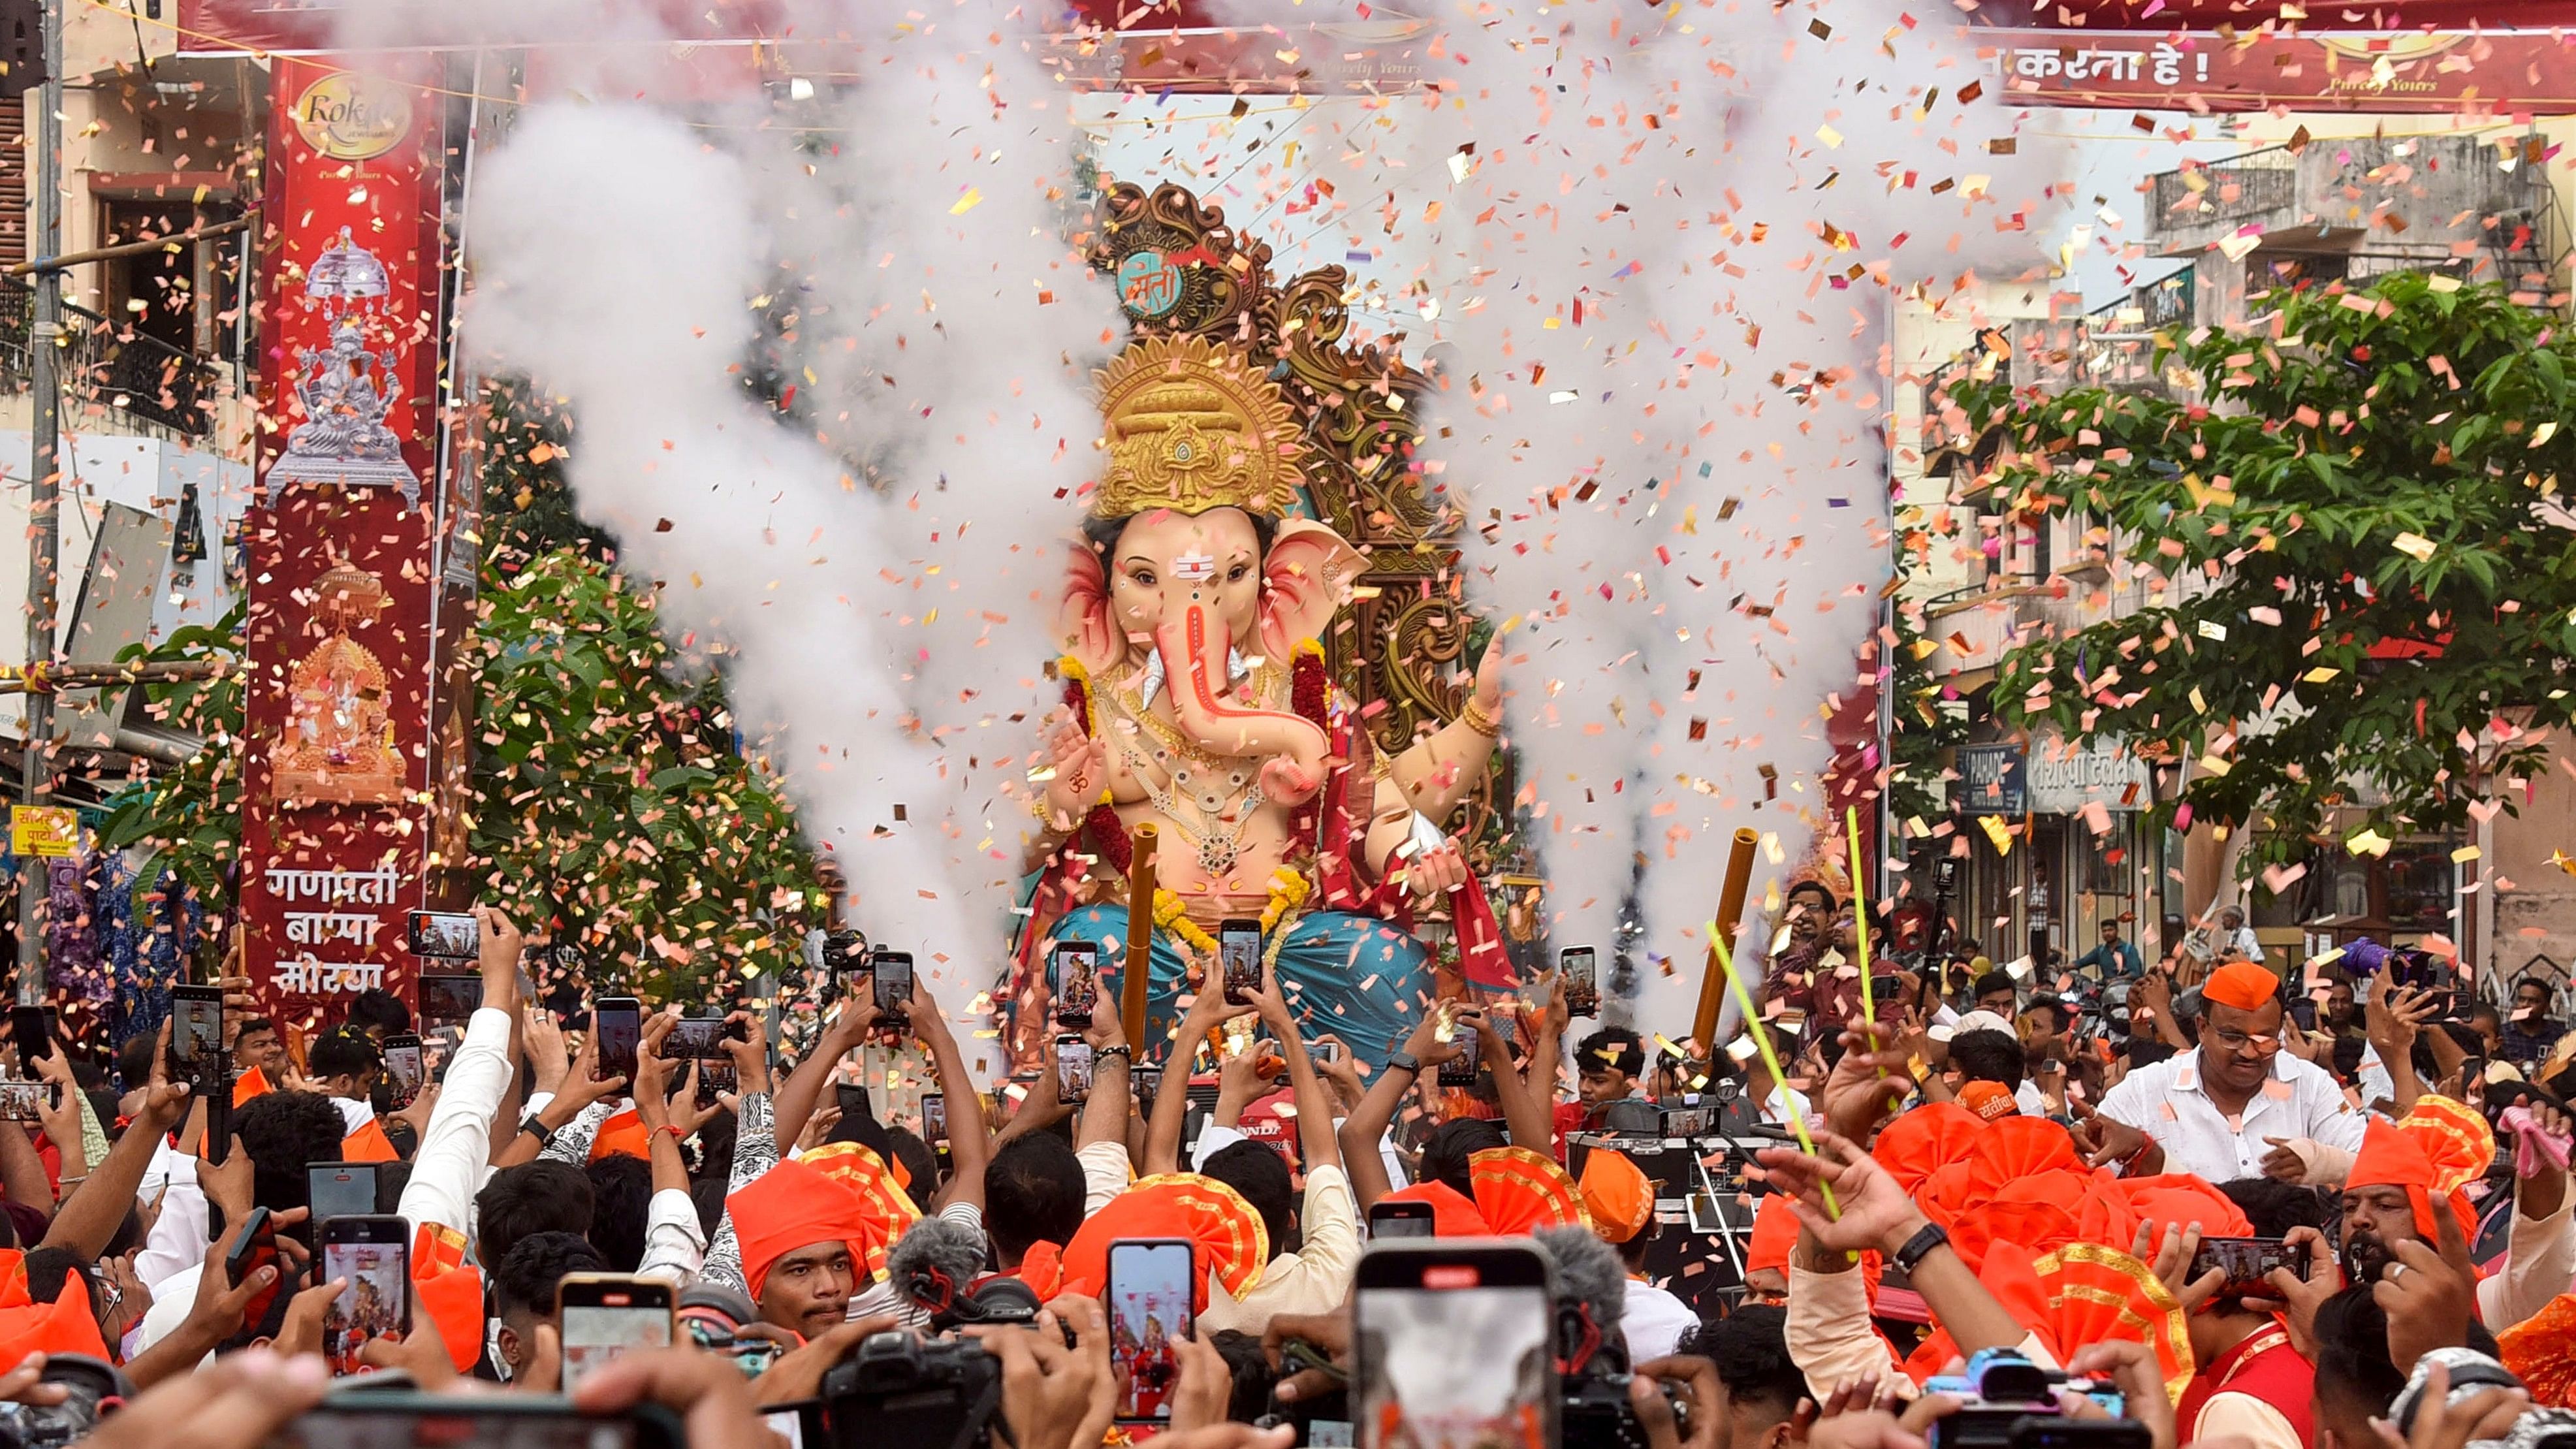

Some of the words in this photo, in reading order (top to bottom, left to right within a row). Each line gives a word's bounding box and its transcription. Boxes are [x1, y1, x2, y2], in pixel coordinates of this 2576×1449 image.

[1380, 61, 1422, 74] Yours
[2014, 48, 2147, 81] करता
[2391, 77, 2438, 91] Yours
[264, 863, 400, 904] गणपती
[283, 912, 378, 946] बाप्पा
[274, 951, 385, 994] मोरया
